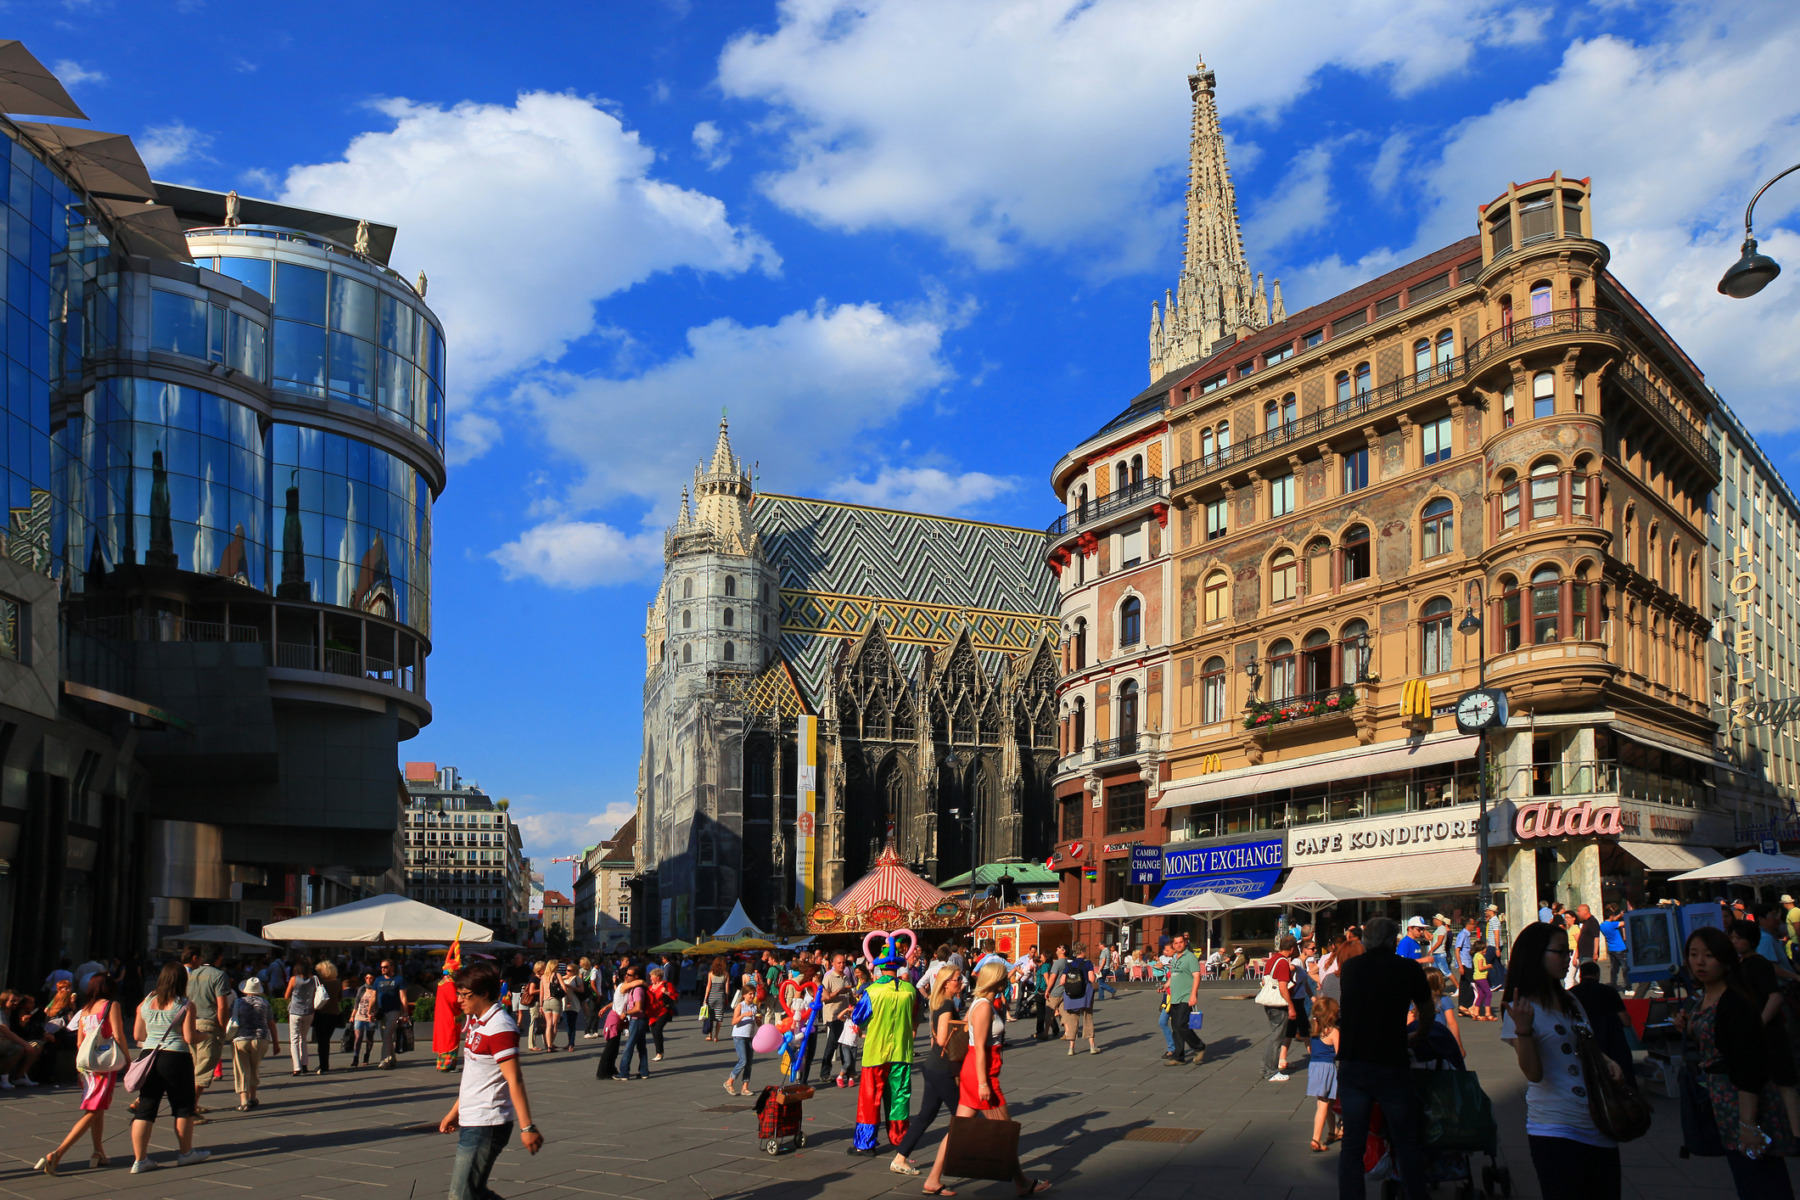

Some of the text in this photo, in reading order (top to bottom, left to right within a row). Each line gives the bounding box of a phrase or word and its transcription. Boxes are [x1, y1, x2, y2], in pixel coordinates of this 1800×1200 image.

[1730, 542, 1757, 685] HOTEL
[1293, 818, 1482, 855] CAFE KONDITORE
[1132, 860, 1161, 869] CHANGE
[1135, 849, 1159, 857] CAMBIO
[1164, 844, 1282, 875] MONEY EXCHANGE
[1166, 889, 1187, 898] THE
[1228, 881, 1265, 893] GROUP
